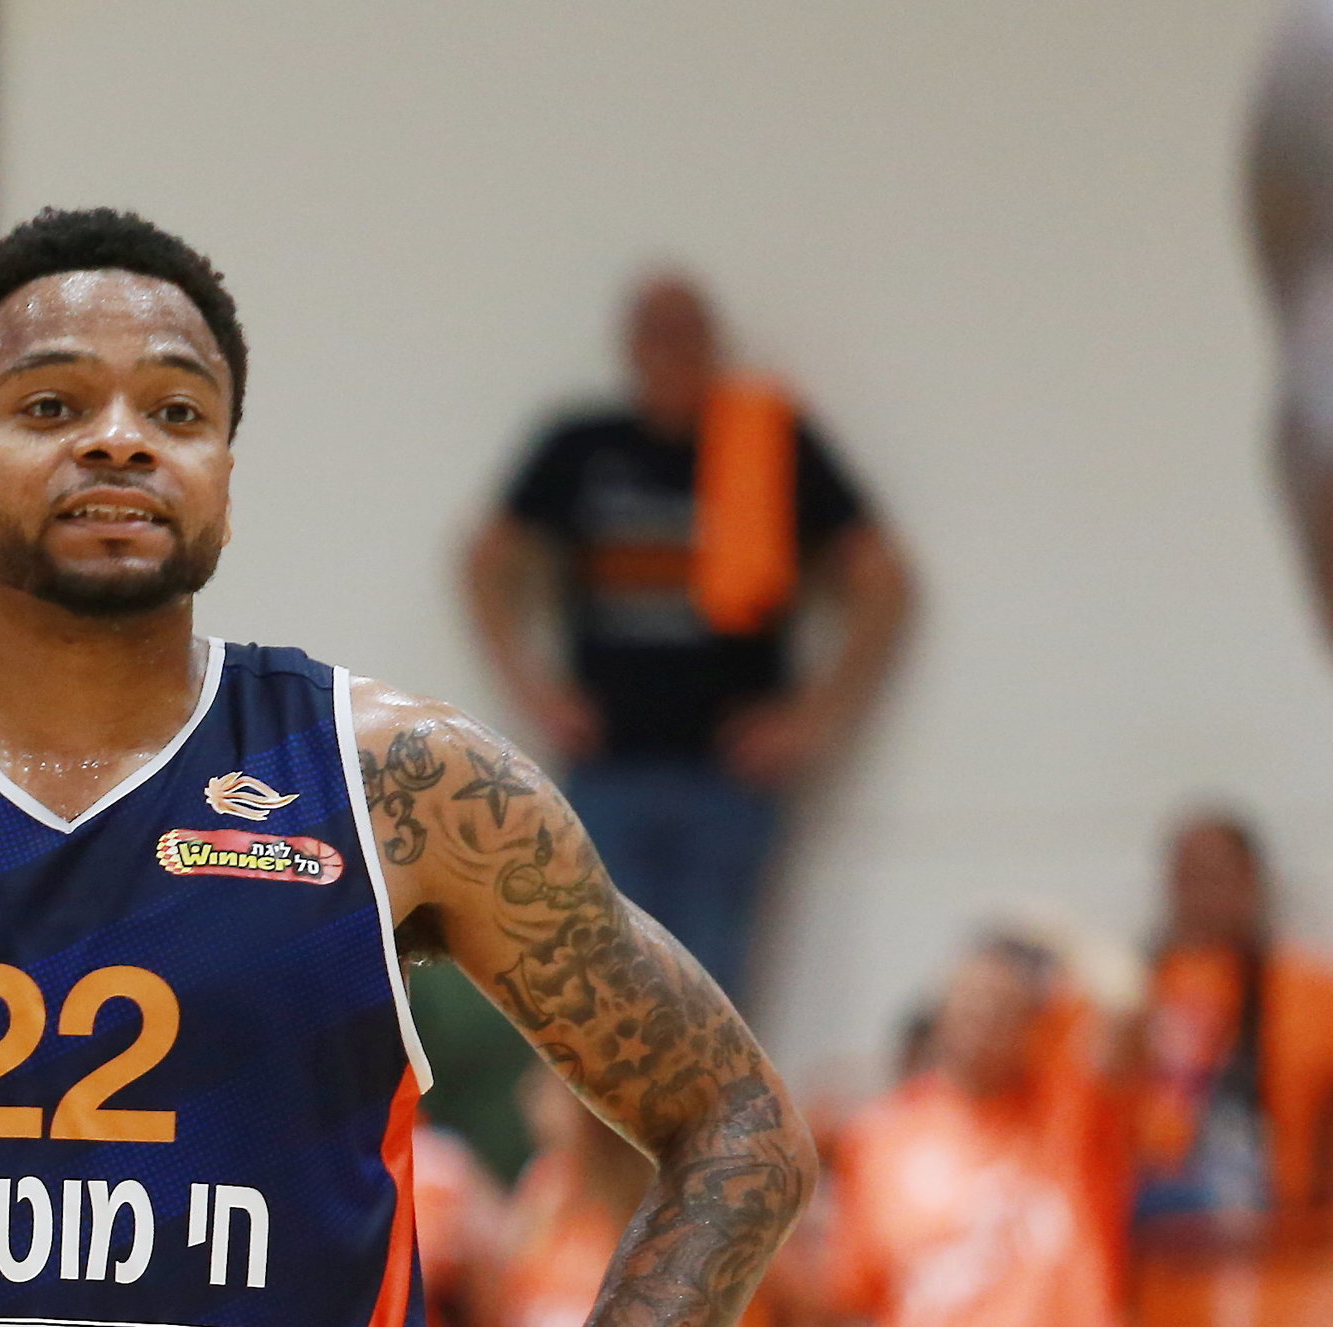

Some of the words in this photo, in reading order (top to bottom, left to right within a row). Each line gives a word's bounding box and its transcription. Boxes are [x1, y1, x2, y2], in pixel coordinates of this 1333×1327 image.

[177, 842, 293, 872] Winner
[251, 841, 292, 857] ליגת
[294, 854, 320, 875] סל
[186, 1181, 270, 1288] חי
